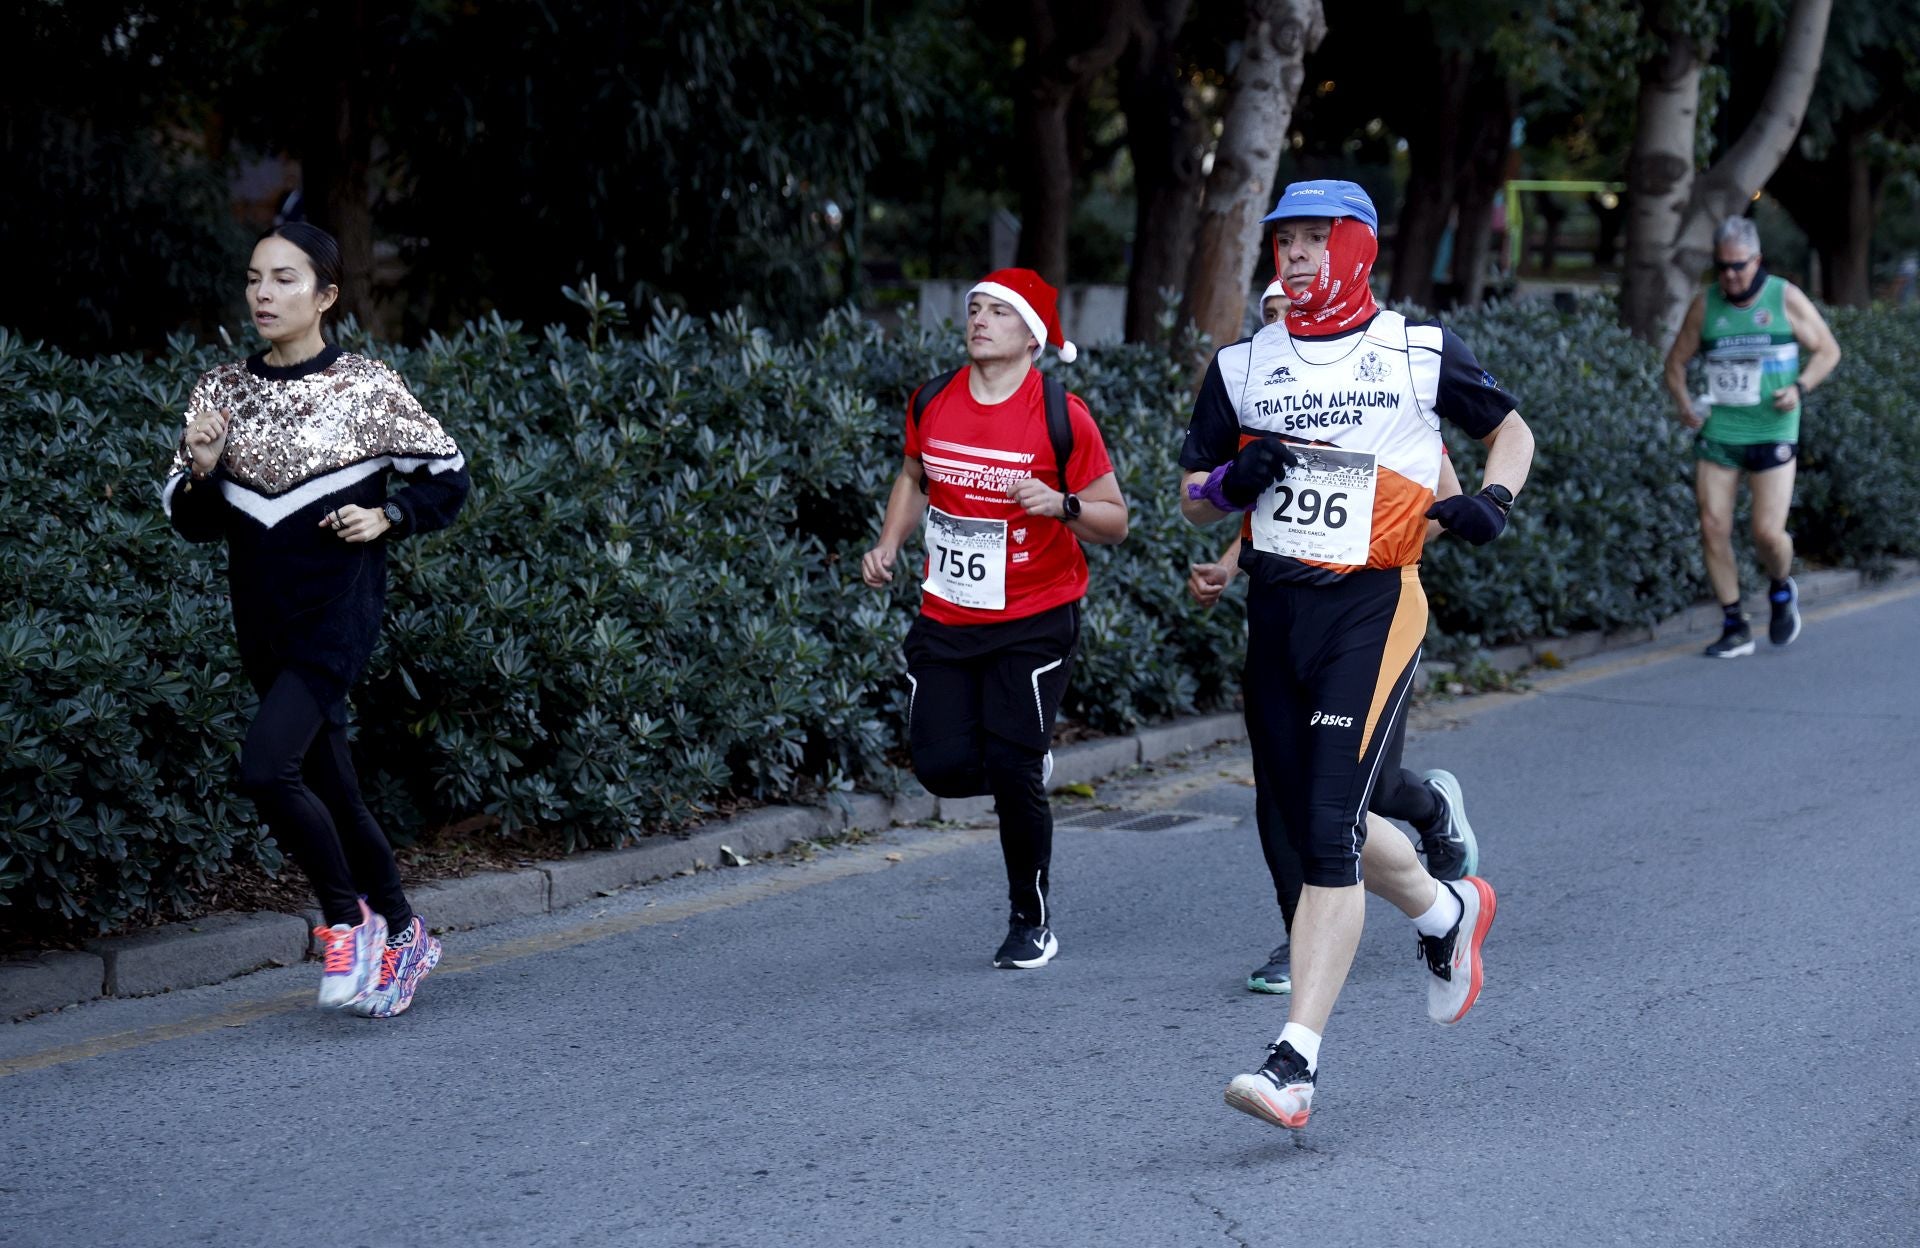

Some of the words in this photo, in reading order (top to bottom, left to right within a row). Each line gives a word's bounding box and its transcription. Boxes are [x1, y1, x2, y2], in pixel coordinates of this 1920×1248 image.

[1254, 389, 1323, 418] TRIATLÓN
[1328, 390, 1400, 409] ALHAURIN
[1284, 409, 1363, 431] SENEGAR
[938, 473, 975, 488] PALMA
[976, 480, 1008, 493] PALM
[963, 470, 982, 480] SAN
[983, 473, 1019, 486] SILVEST
[980, 465, 1032, 480] CARRERA
[1273, 486, 1348, 529] 296
[936, 544, 986, 582] 756
[1320, 714, 1354, 728] asics
